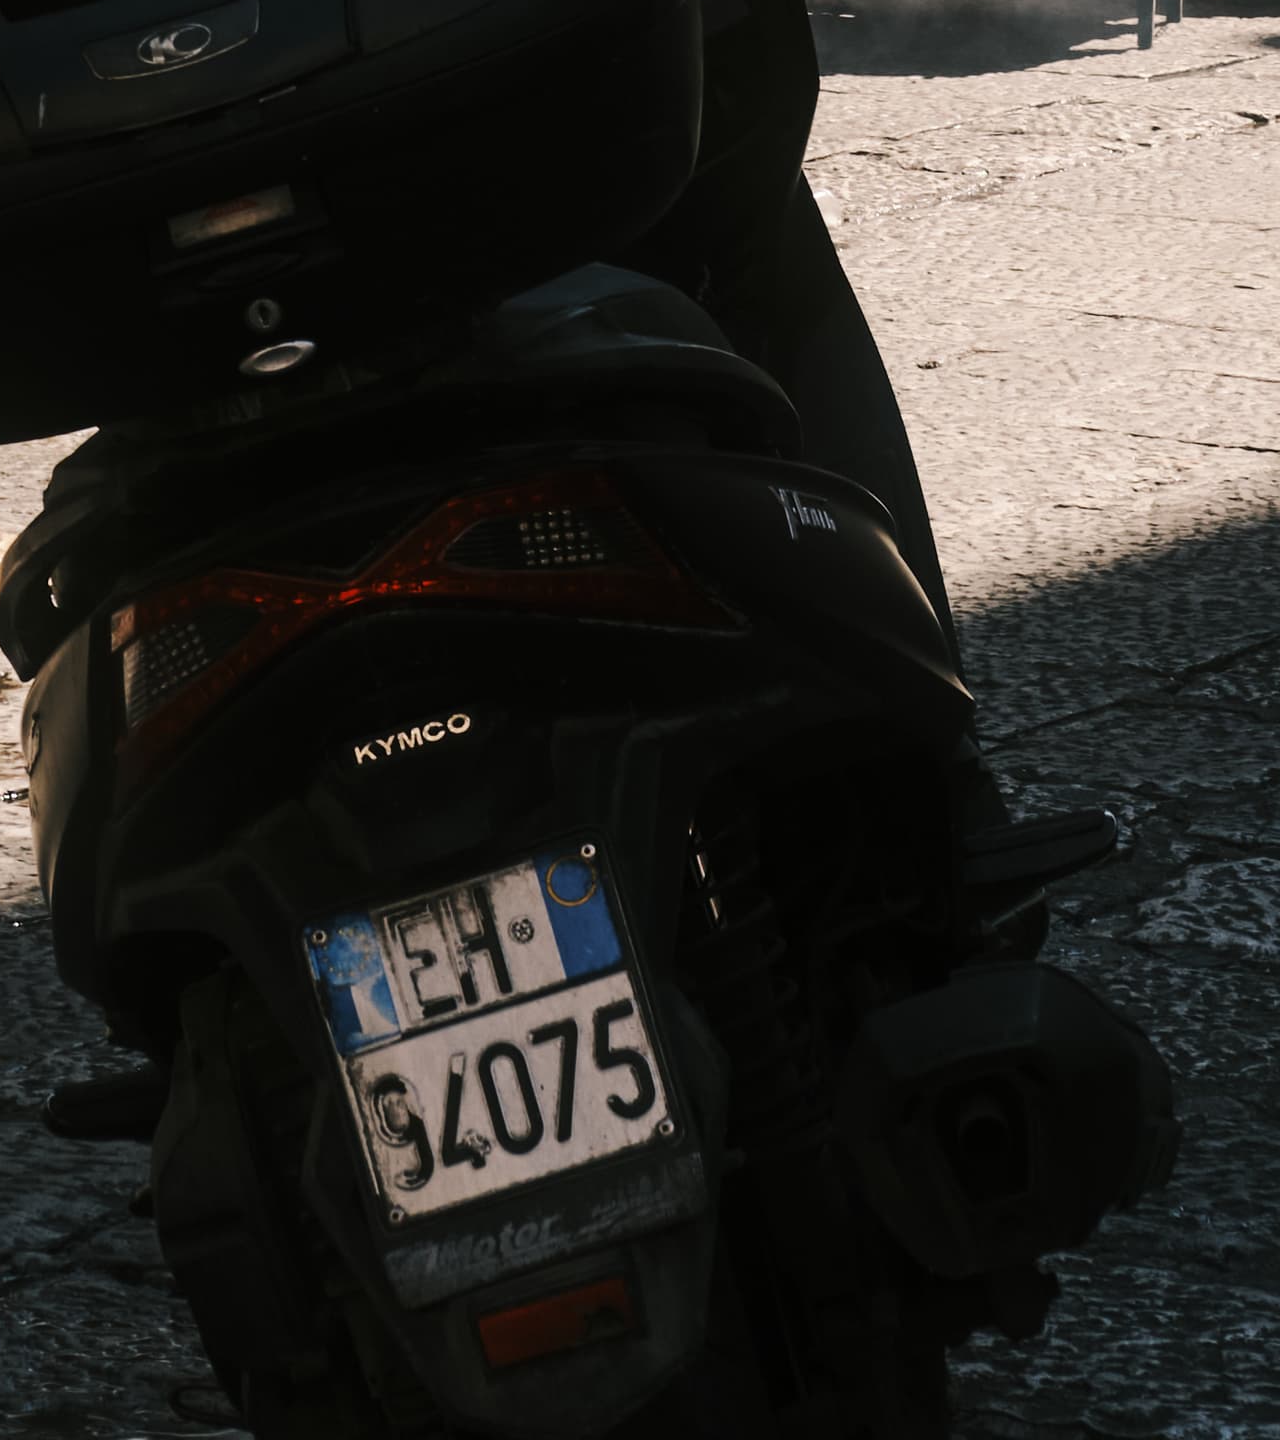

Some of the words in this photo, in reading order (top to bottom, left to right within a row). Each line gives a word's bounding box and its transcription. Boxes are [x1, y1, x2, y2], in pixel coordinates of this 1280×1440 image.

[352, 710, 475, 768] KYMCO
[383, 884, 514, 1020] EH
[370, 1000, 658, 1192] 94075
